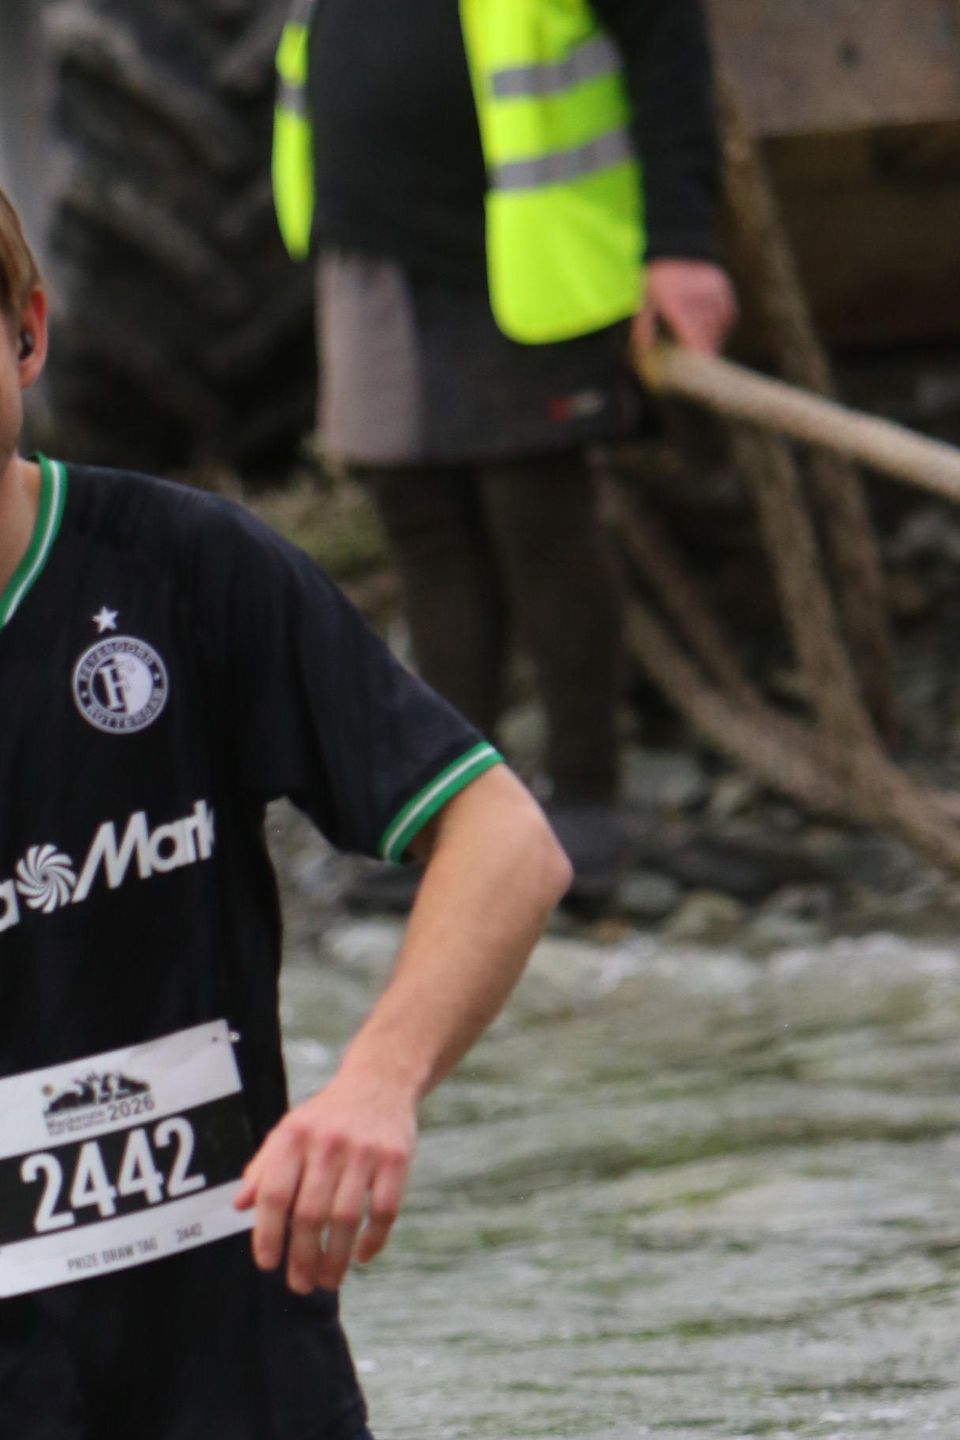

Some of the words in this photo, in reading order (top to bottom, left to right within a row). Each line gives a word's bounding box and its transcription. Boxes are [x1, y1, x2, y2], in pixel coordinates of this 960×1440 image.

[107, 1094, 155, 1121] 2026
[20, 1116, 206, 1233] 2442
[67, 1252, 98, 1271] PRIZE
[102, 1244, 135, 1263] DRAW
[136, 1237, 158, 1254] TAG
